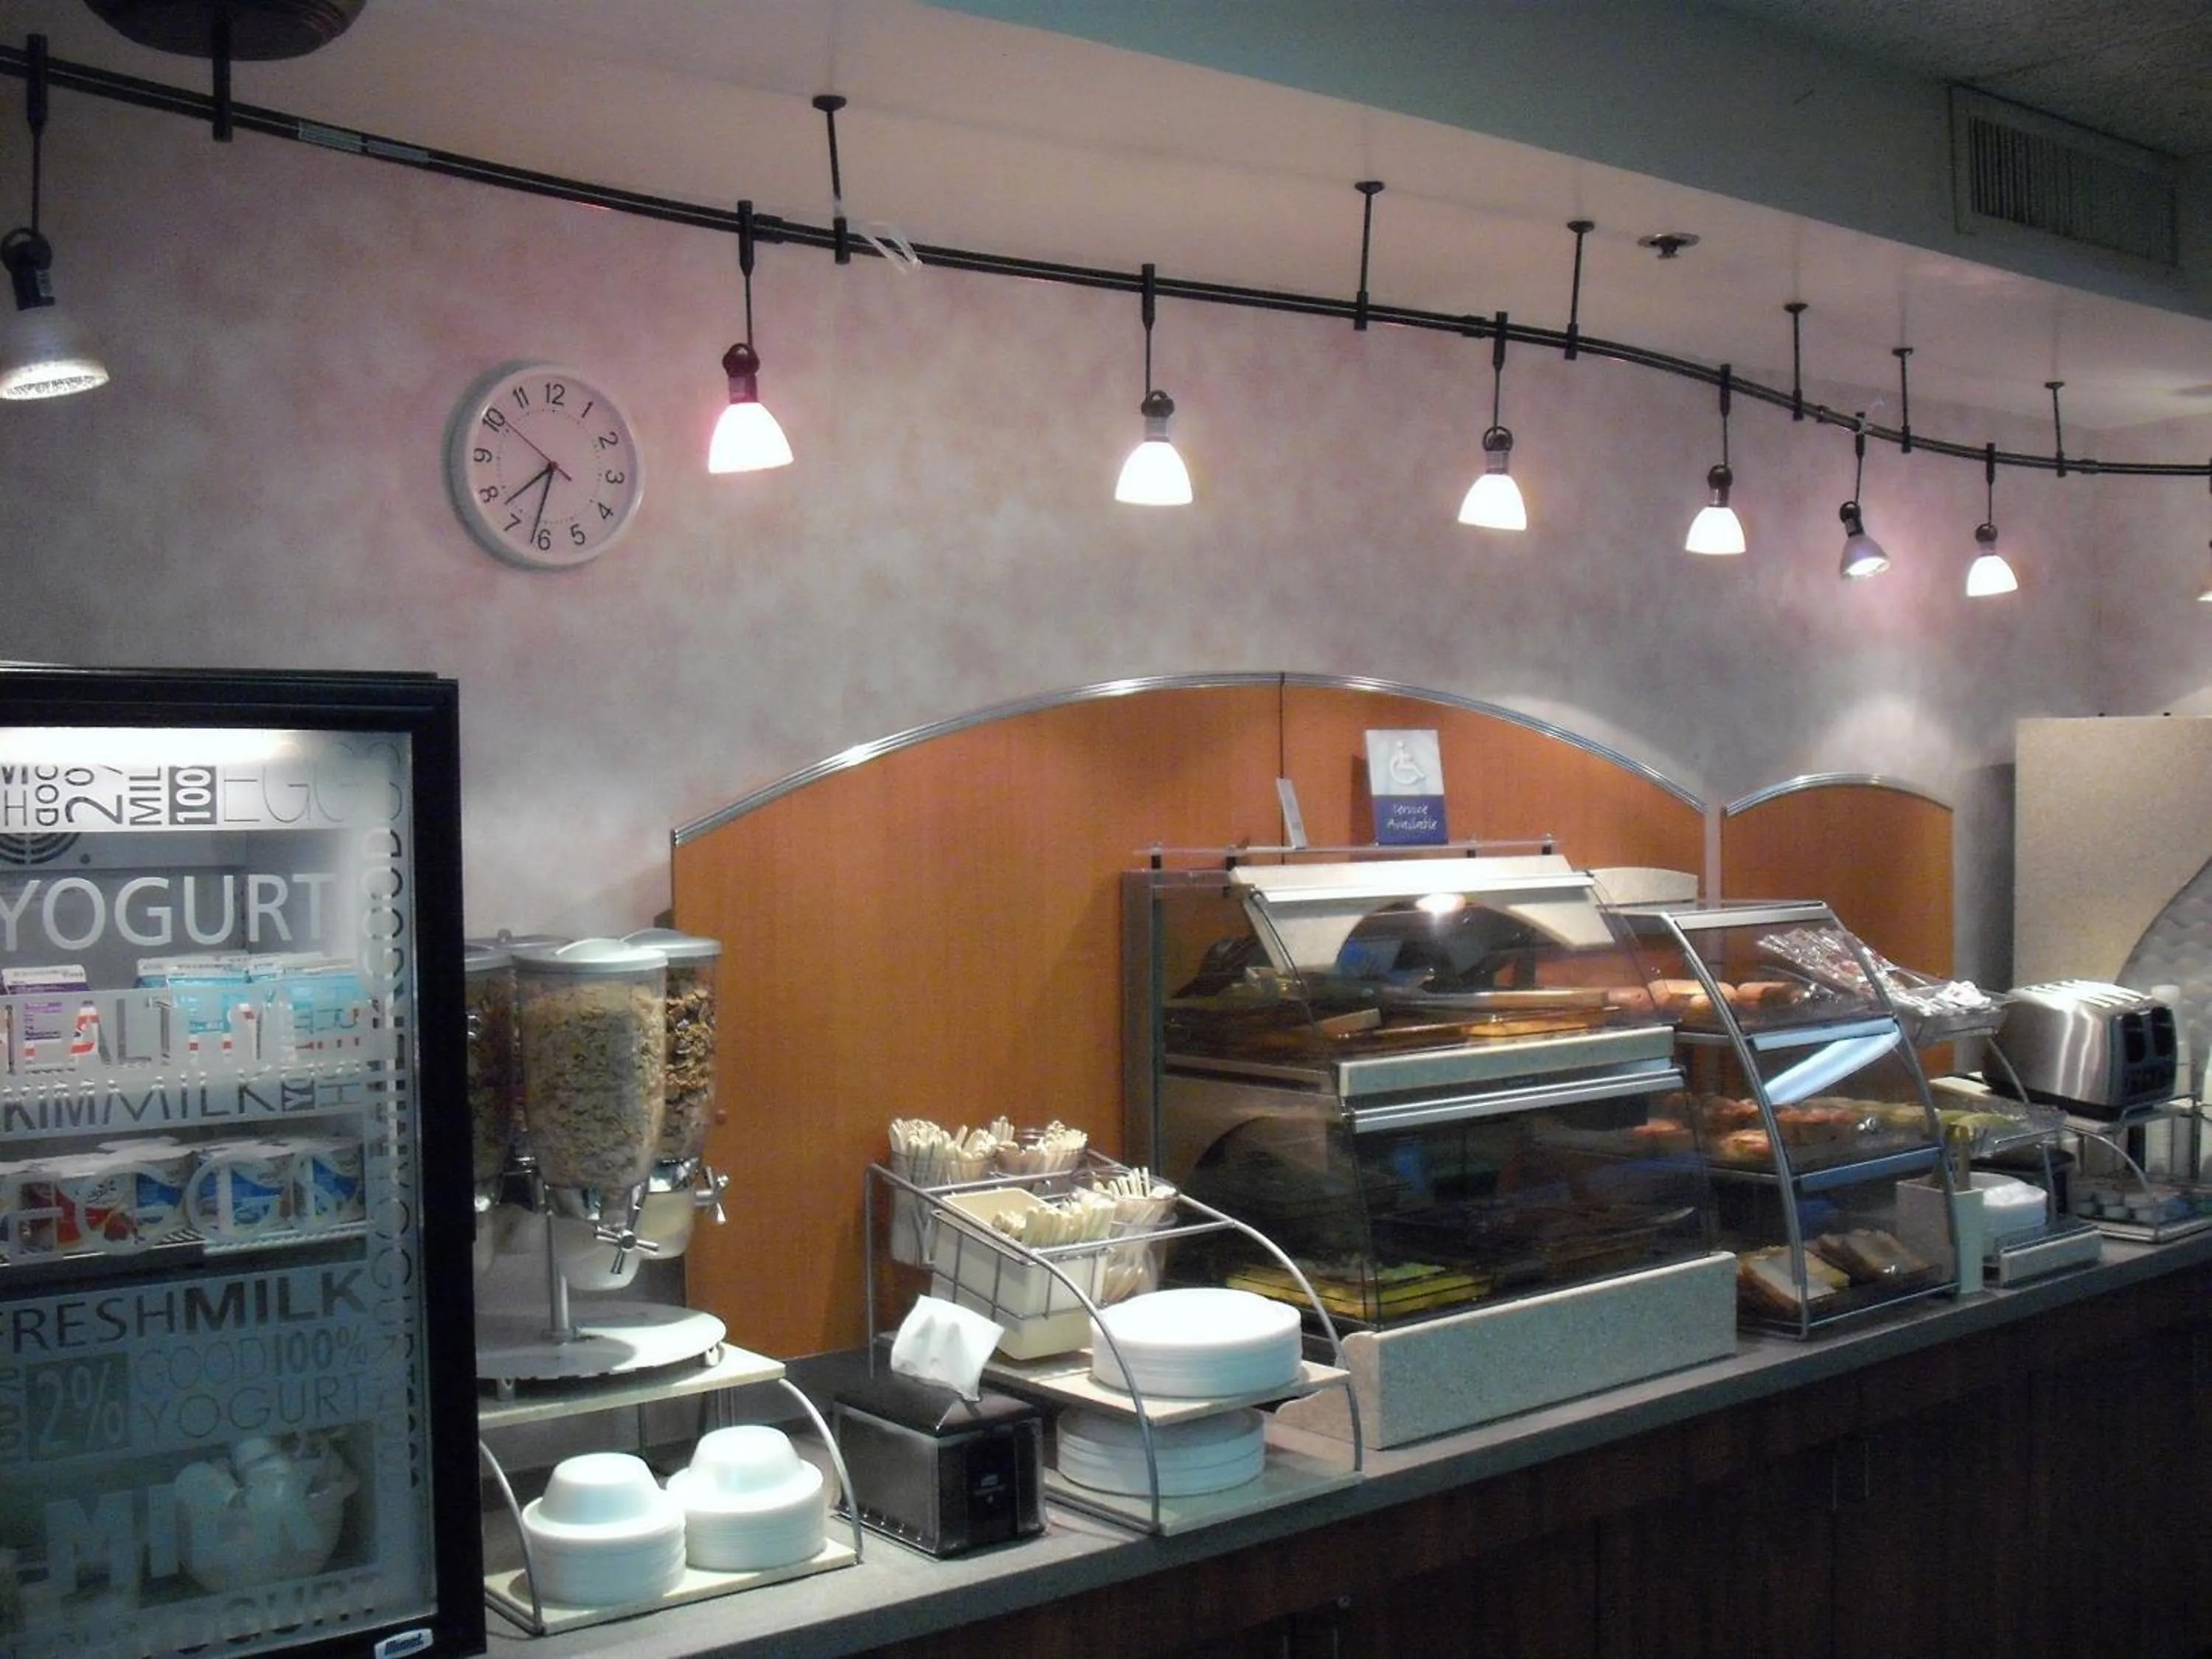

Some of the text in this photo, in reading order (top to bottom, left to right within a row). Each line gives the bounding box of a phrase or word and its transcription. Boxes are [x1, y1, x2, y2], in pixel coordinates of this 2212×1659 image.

[512, 386, 530, 408] 11
[545, 382, 566, 406] 12
[481, 407, 506, 433] 10
[580, 400, 594, 418] 1
[598, 431, 619, 449] 2
[473, 447, 493, 463] 9
[605, 470, 625, 484] 3
[479, 485, 499, 503] 8
[597, 501, 614, 520] 4
[503, 512, 522, 532] 7
[537, 528, 552, 551] 6
[569, 523, 586, 545] 5
[35, 765, 60, 827] OOD
[129, 765, 162, 826] MIL
[174, 765, 212, 824] 100
[0, 874, 335, 953] YOGURT
[139, 1371, 370, 1439] YOGURT
